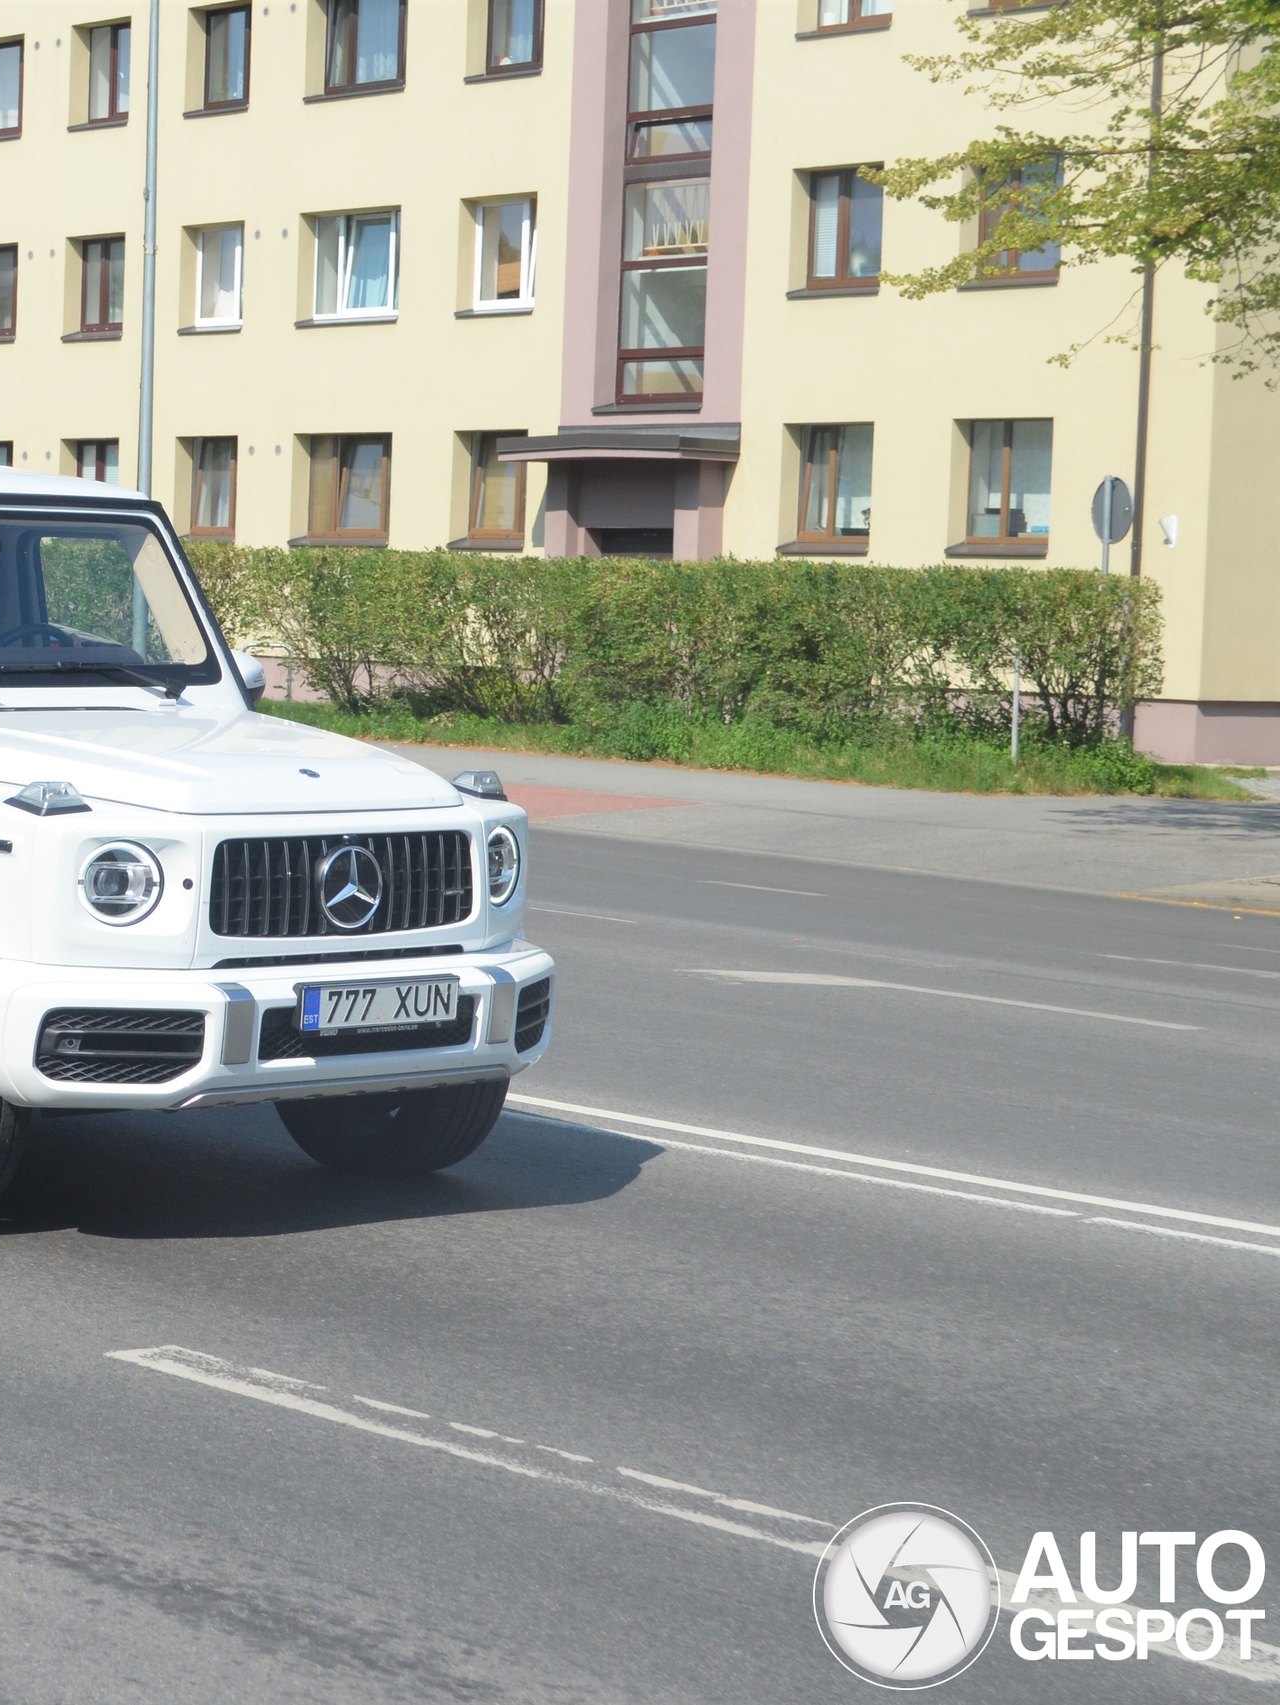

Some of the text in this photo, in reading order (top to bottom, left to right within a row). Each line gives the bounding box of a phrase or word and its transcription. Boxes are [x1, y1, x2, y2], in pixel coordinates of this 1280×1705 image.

[327, 983, 452, 1024] 777 XUN
[304, 1014, 319, 1024] EST
